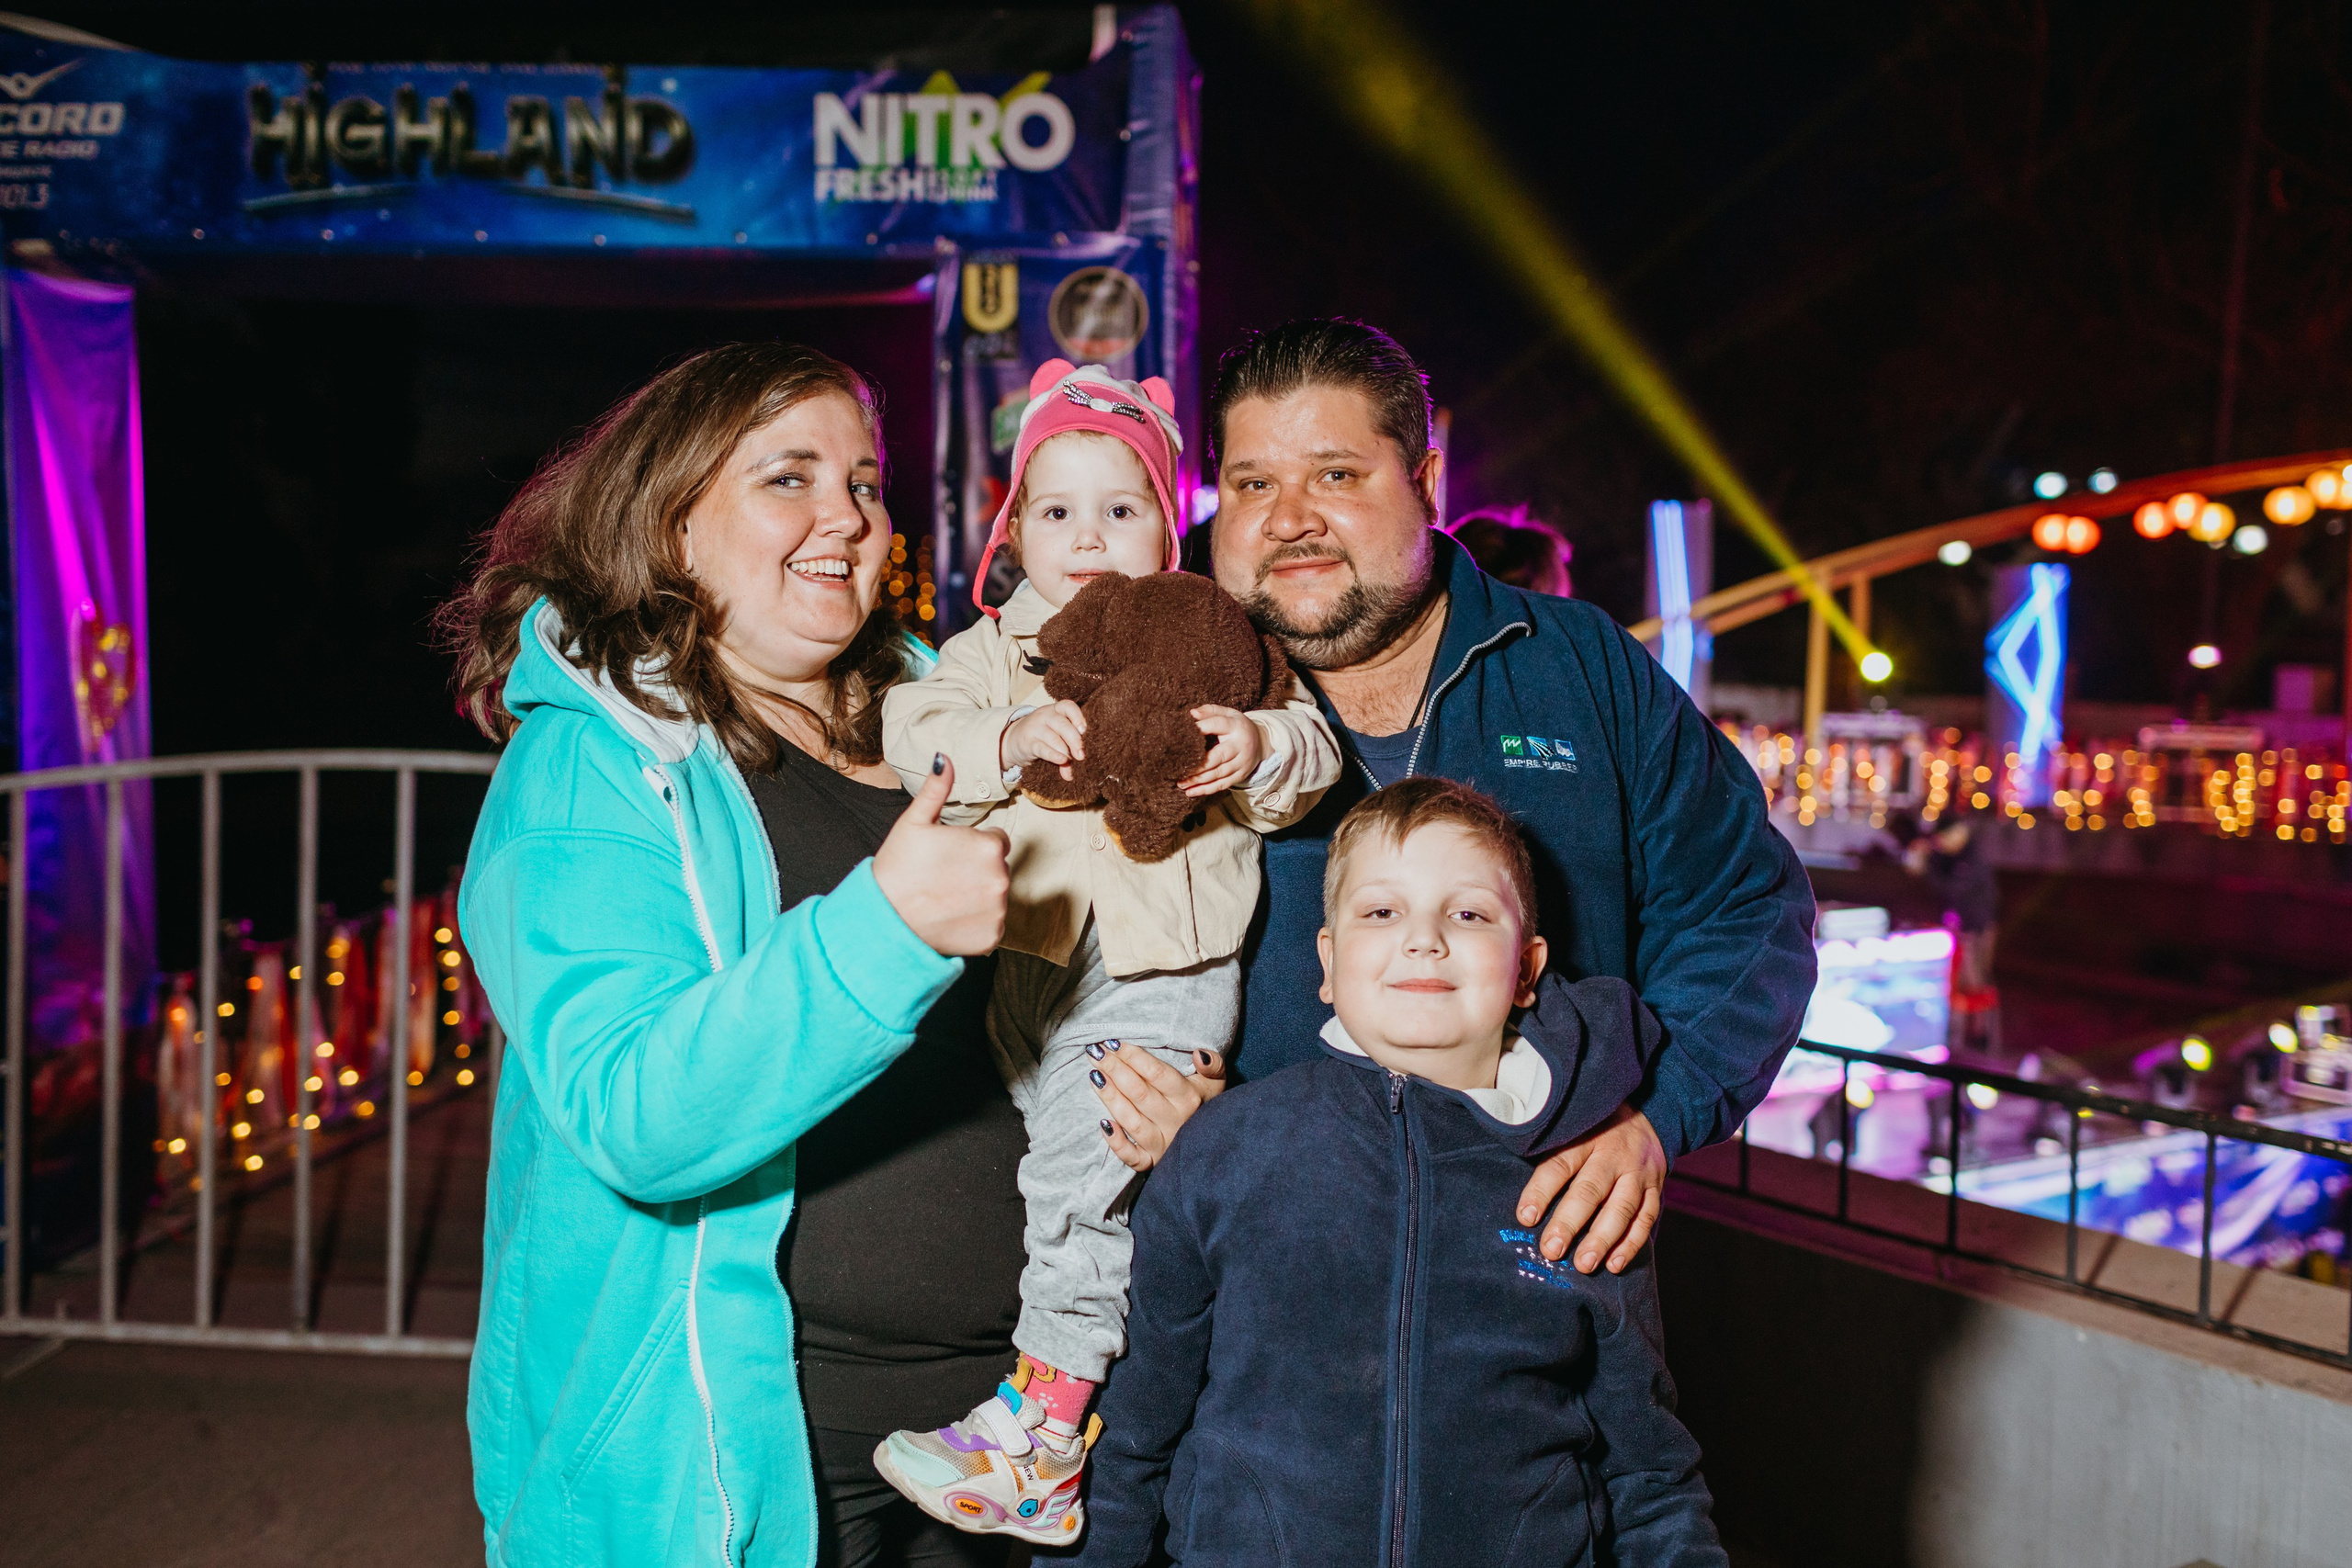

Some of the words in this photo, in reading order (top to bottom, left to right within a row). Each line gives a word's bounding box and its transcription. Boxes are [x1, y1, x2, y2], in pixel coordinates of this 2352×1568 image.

[246, 81, 695, 189] HIGHLAND
[814, 167, 925, 203] FRESH
[959, 1501, 982, 1514] SPORT
